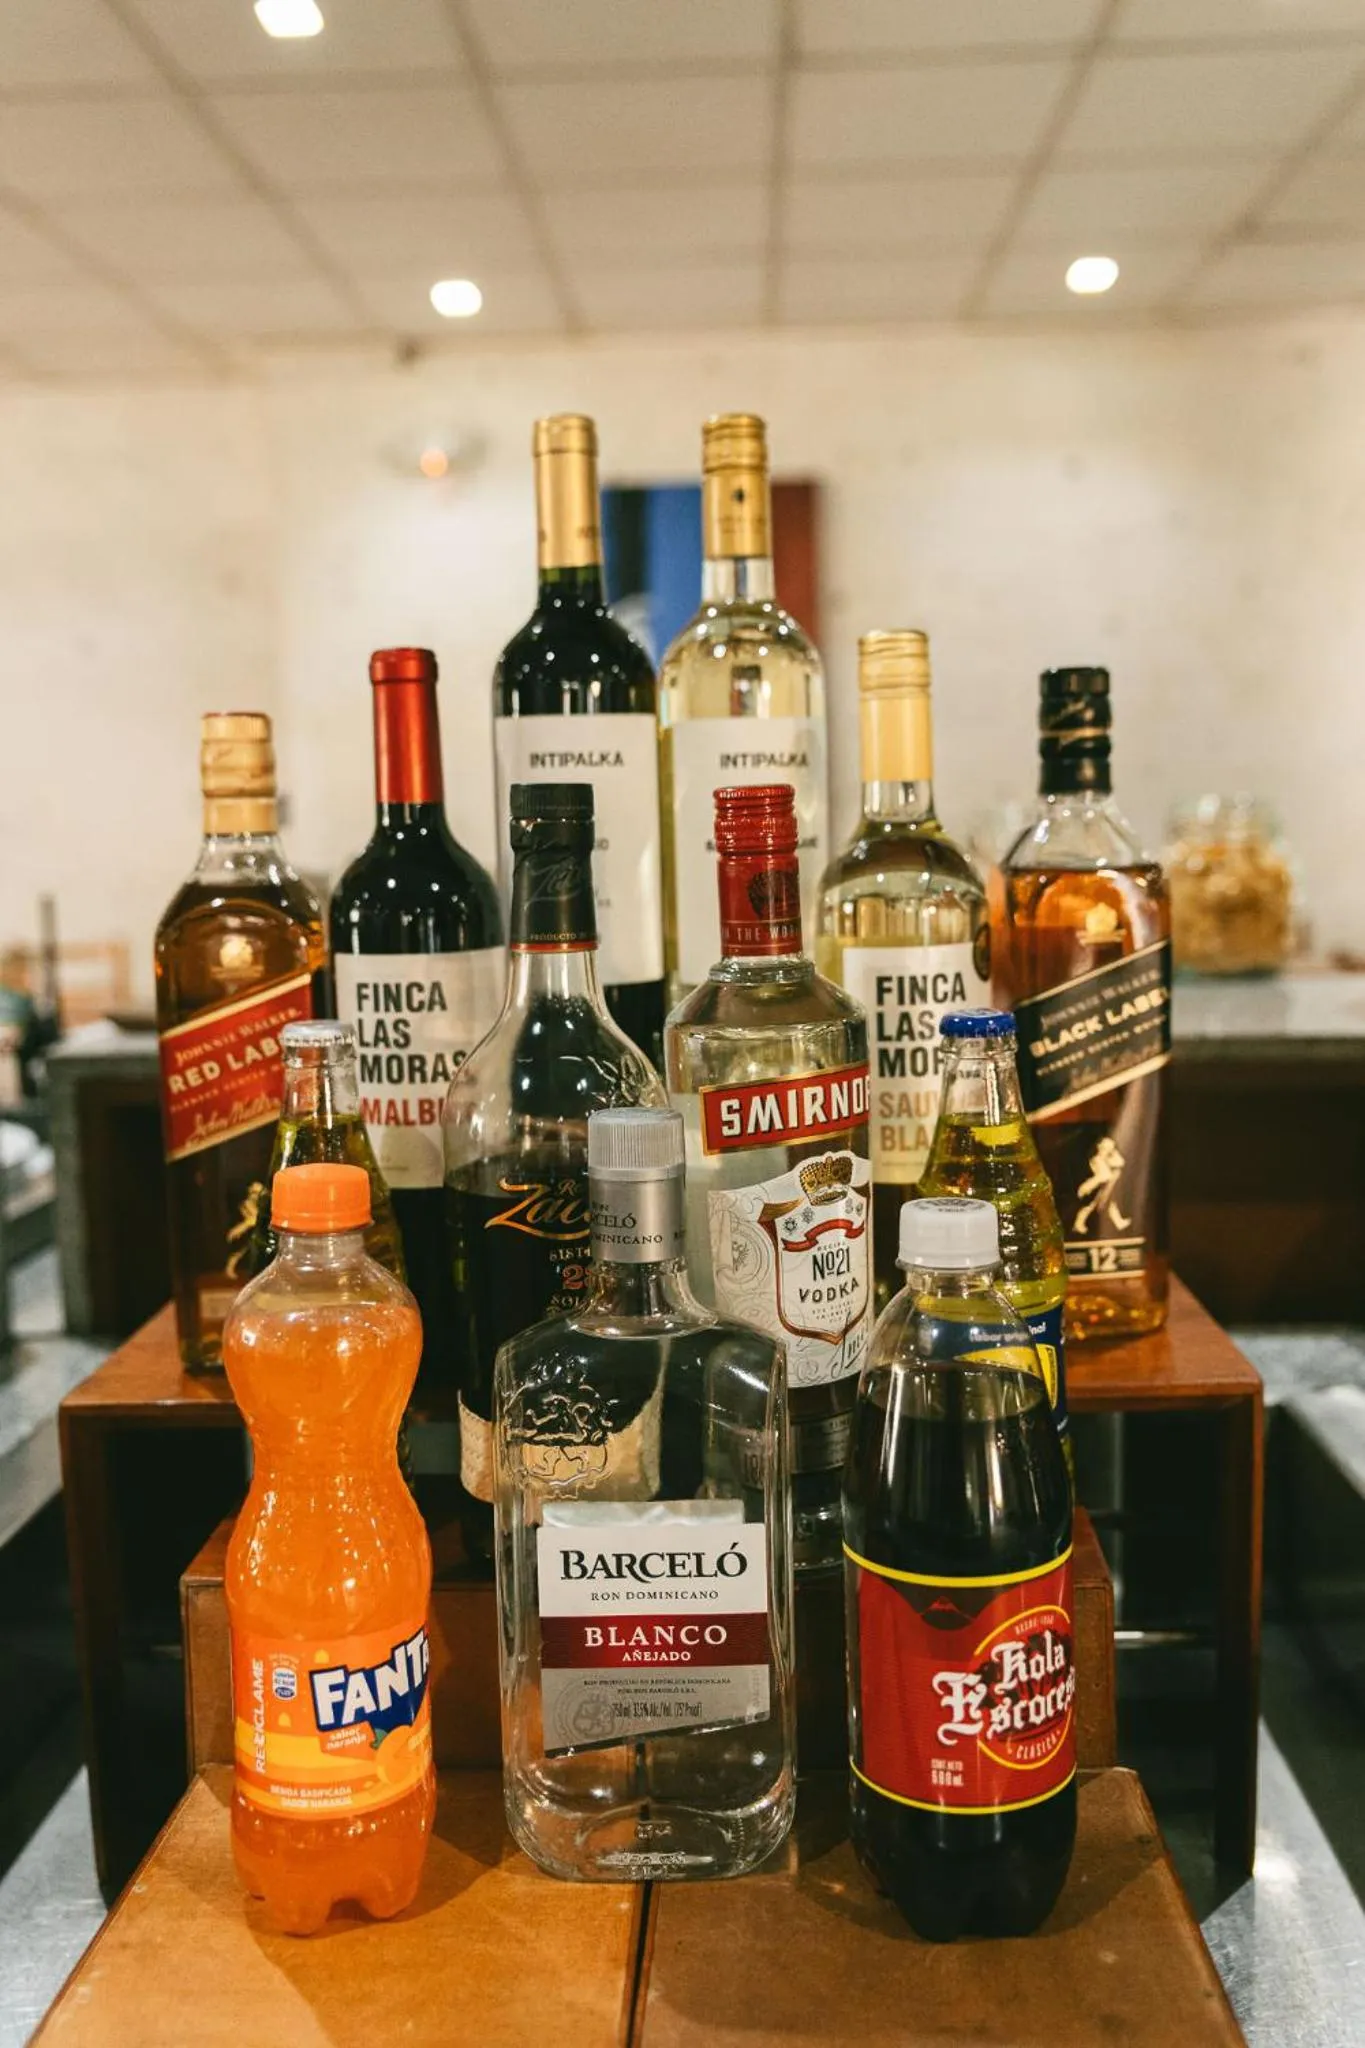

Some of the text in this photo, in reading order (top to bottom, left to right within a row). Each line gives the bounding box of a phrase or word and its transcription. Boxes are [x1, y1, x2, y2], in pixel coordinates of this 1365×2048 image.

[530, 753, 624, 769] INTIPALKA
[720, 753, 809, 769] INTIPALKA
[737, 927, 760, 941] THE
[356, 981, 448, 1013] FINCA
[876, 972, 967, 1006] FINCA
[357, 1018, 411, 1049] LAS
[877, 1010, 936, 1042] LAS
[1029, 1015, 1104, 1058] BLACK
[168, 1060, 222, 1095] RED
[225, 1035, 282, 1071] LAB
[880, 1124, 930, 1152] BLA
[484, 1177, 592, 1241] Zac
[1089, 1246, 1117, 1272] 12
[799, 1277, 860, 1304] VODKA
[560, 1542, 748, 1585] BARCELÓ
[591, 1590, 719, 1601] RON DOMINICANO
[584, 1625, 728, 1648] BLANCO
[622, 1651, 692, 1662] AÑEJADO
[991, 1629, 1066, 1695] Kola
